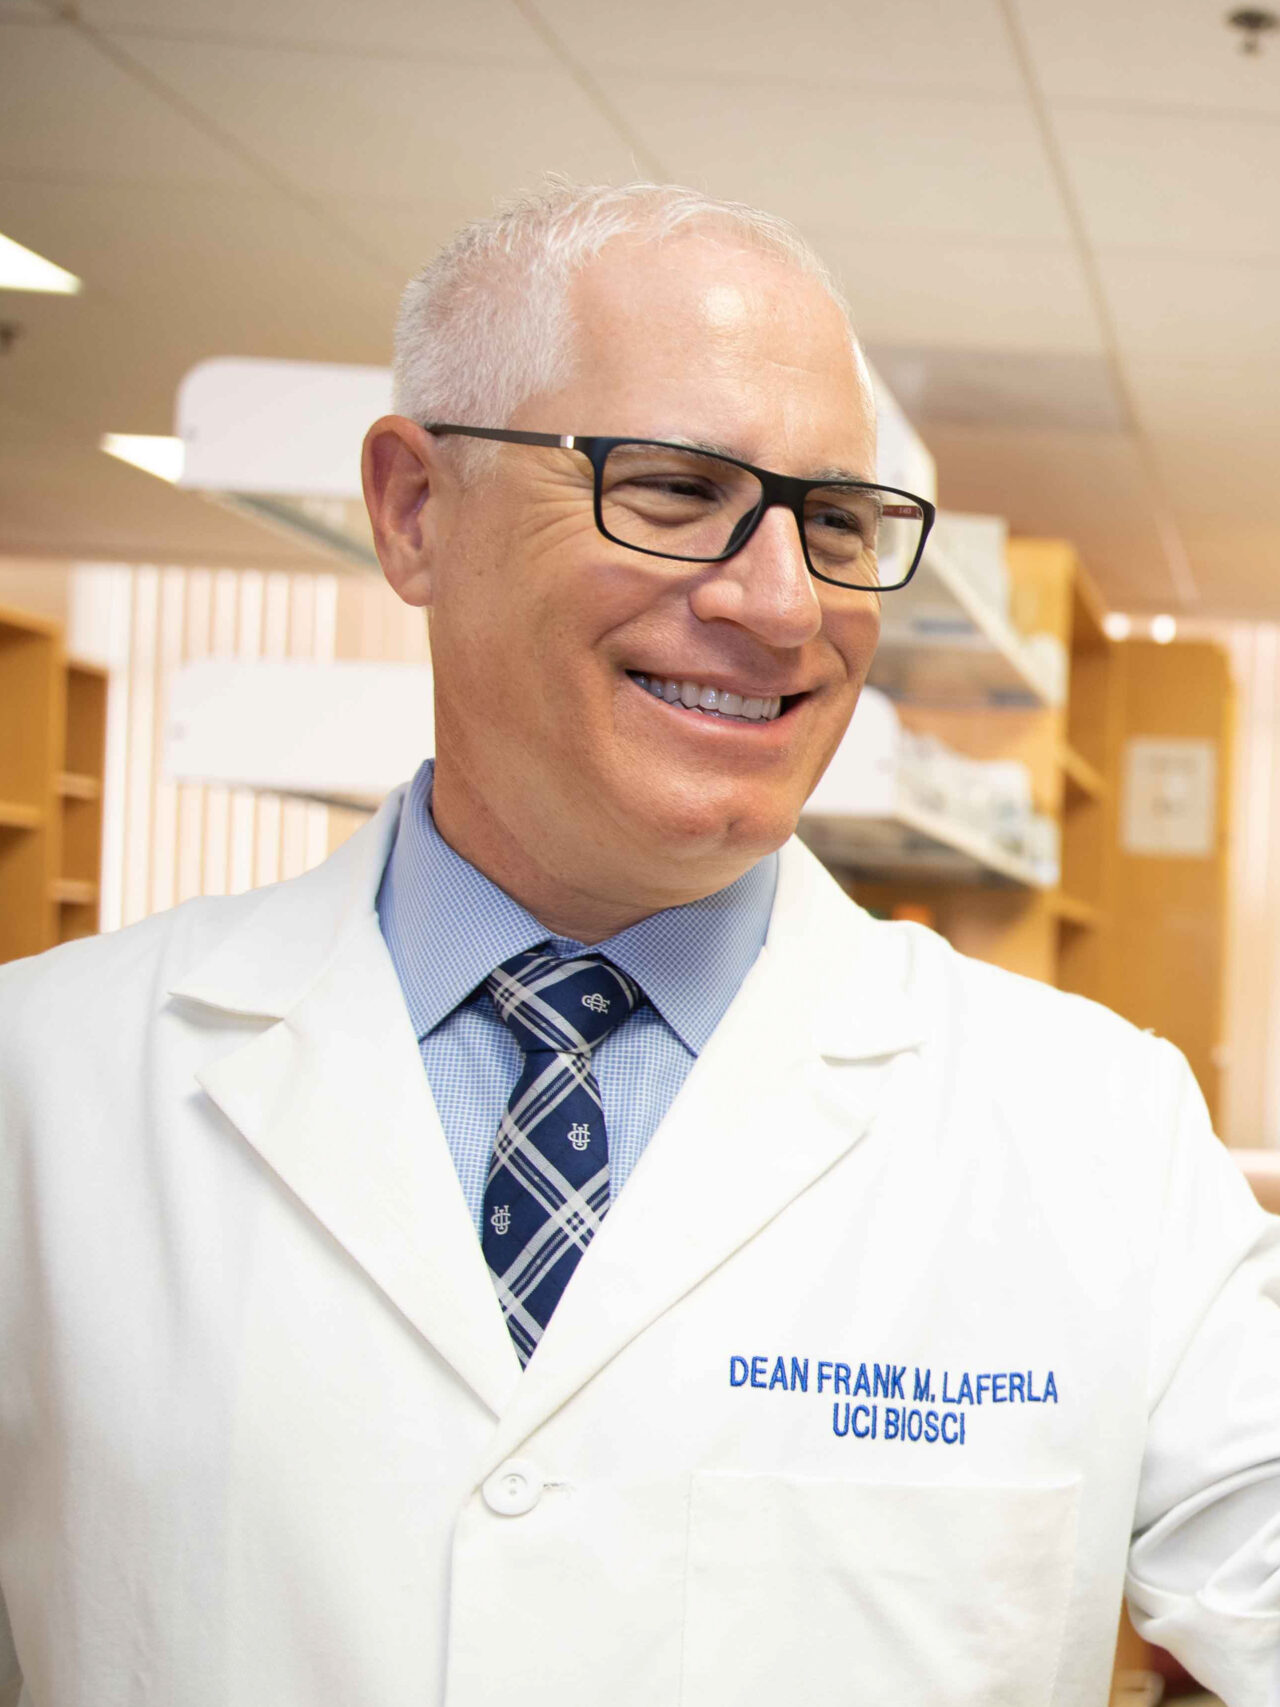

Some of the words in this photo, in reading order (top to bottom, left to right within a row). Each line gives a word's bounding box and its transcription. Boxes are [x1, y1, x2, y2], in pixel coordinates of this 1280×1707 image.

[729, 1355, 809, 1393] DEAN
[817, 1361, 907, 1400] FRANK
[912, 1367, 936, 1403] M.
[941, 1370, 1059, 1406] LAFERLA
[832, 1402, 878, 1440] UCI
[883, 1406, 966, 1446] BIOSCI
